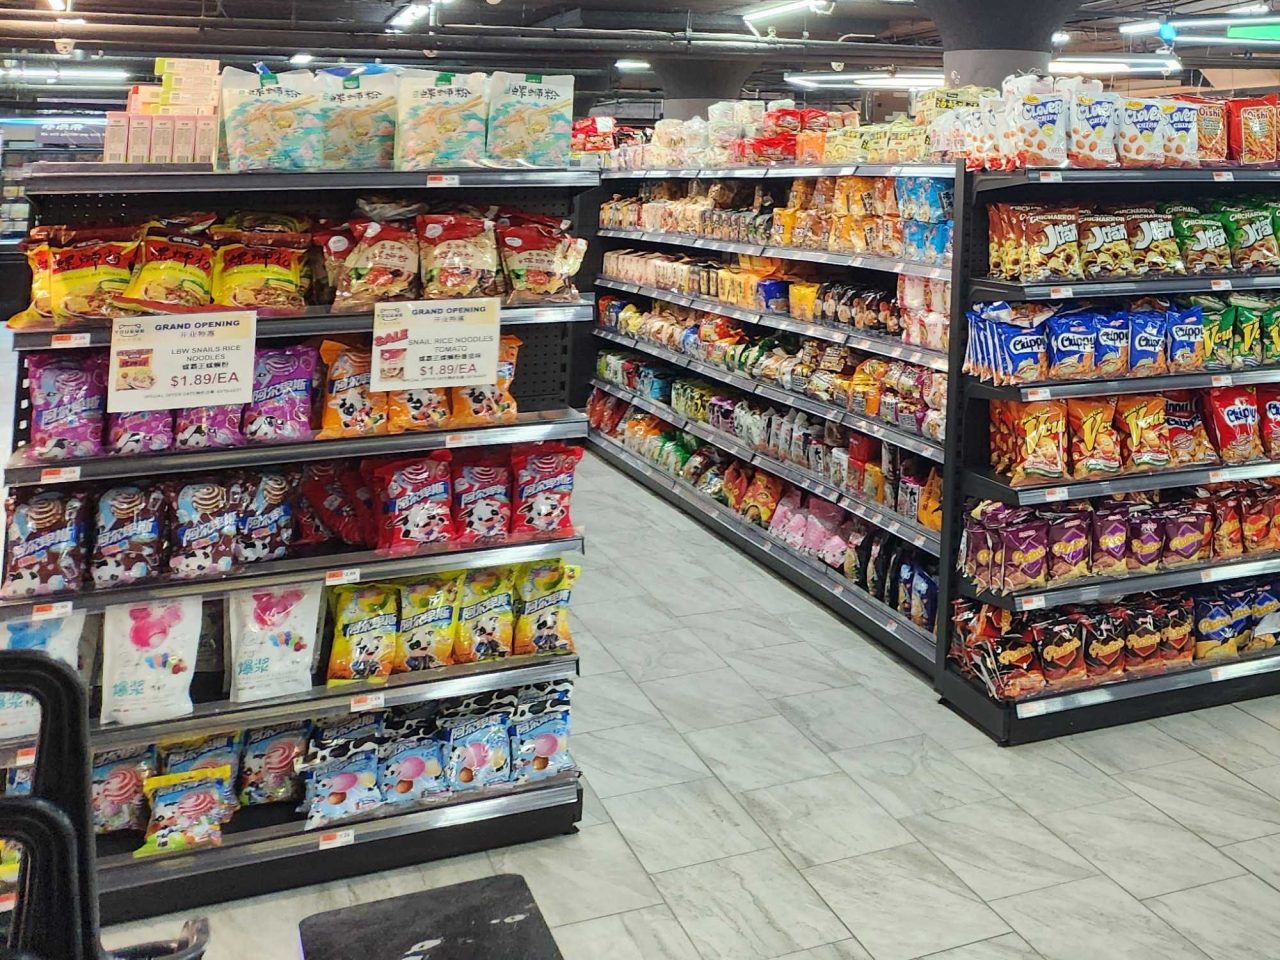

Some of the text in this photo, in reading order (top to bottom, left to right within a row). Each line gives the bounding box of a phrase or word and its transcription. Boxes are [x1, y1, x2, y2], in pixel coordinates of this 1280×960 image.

[412, 306, 486, 316] GRAND OPENING
[155, 320, 240, 331] GRAND OPENING
[374, 329, 409, 347] SALE
[420, 364, 478, 376] $1.89/EA
[170, 371, 240, 387] $1.89/EA
